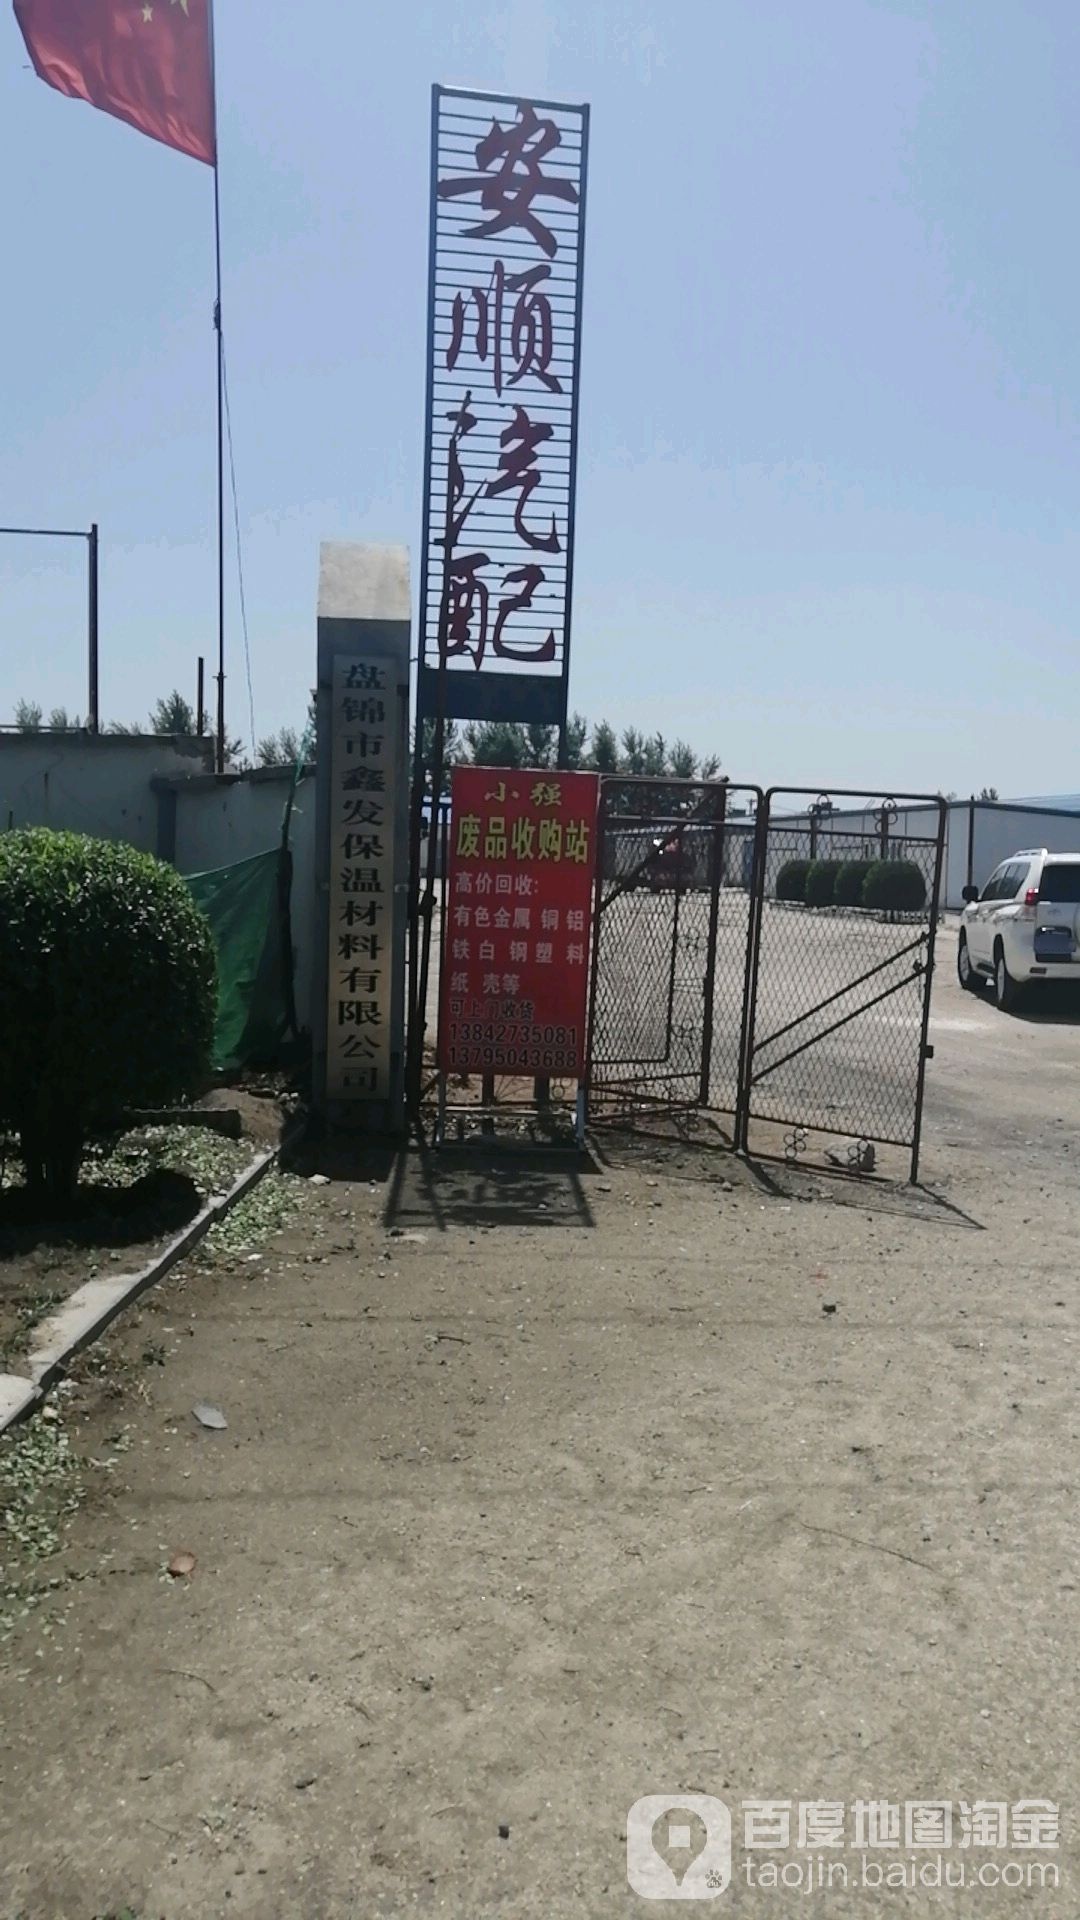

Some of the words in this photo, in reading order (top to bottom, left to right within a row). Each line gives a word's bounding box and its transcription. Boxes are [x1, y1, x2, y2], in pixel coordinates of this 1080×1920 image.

[437, 106, 579, 670] 安顺汽配
[484, 782, 562, 806] 小强
[456, 814, 590, 864] 废品收购站
[338, 662, 386, 1093] 盘锦市鑫发保温材料有限公司
[455, 871, 539, 895] 高价回收:
[449, 1023, 577, 1046] 13842735081
[448, 1046, 577, 1068] 13795043688
